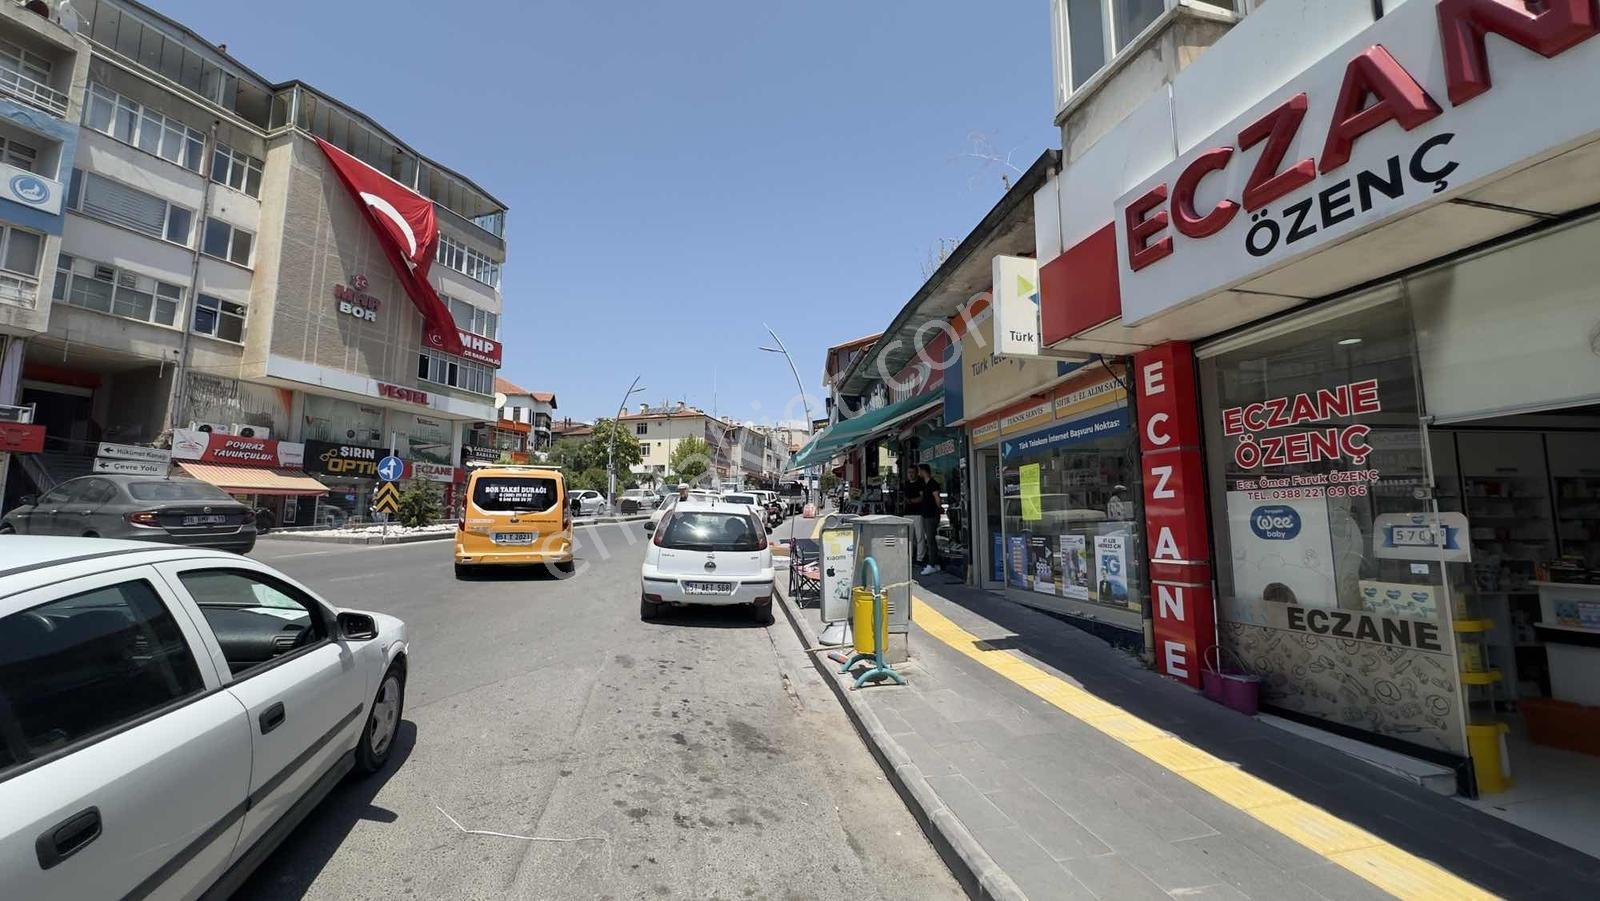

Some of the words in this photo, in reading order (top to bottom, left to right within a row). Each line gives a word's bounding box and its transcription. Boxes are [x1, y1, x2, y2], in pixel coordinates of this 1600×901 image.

[1245, 132, 1459, 257] ÖZENÇ
[340, 301, 377, 322] BOR
[459, 332, 494, 354] MHP
[1010, 330, 1034, 343] Türk
[972, 357, 988, 377] Türk
[377, 382, 430, 406] VESTEL
[1223, 378, 1382, 437] ECZANE
[214, 449, 273, 462] TAVUKÇULUK
[225, 440, 266, 452] POYRAZ
[1235, 423, 1374, 470] ÖZENÇ
[114, 462, 138, 472] Çevre
[140, 464, 158, 473] Yolu
[415, 464, 453, 476] ECZANE
[1261, 473, 1291, 489] Ömer
[1292, 472, 1328, 487] Faruk
[1329, 468, 1380, 484] ÖZENÇ
[1247, 490, 1271, 500] TEL.
[1273, 489, 1300, 500] 0388
[1304, 488, 1325, 498] 221
[1326, 487, 1346, 497] 09
[1348, 485, 1367, 496] 86
[1144, 361, 1188, 679] ECZANE
[1267, 531, 1286, 539] baby
[1287, 605, 1441, 653] ECZANE
